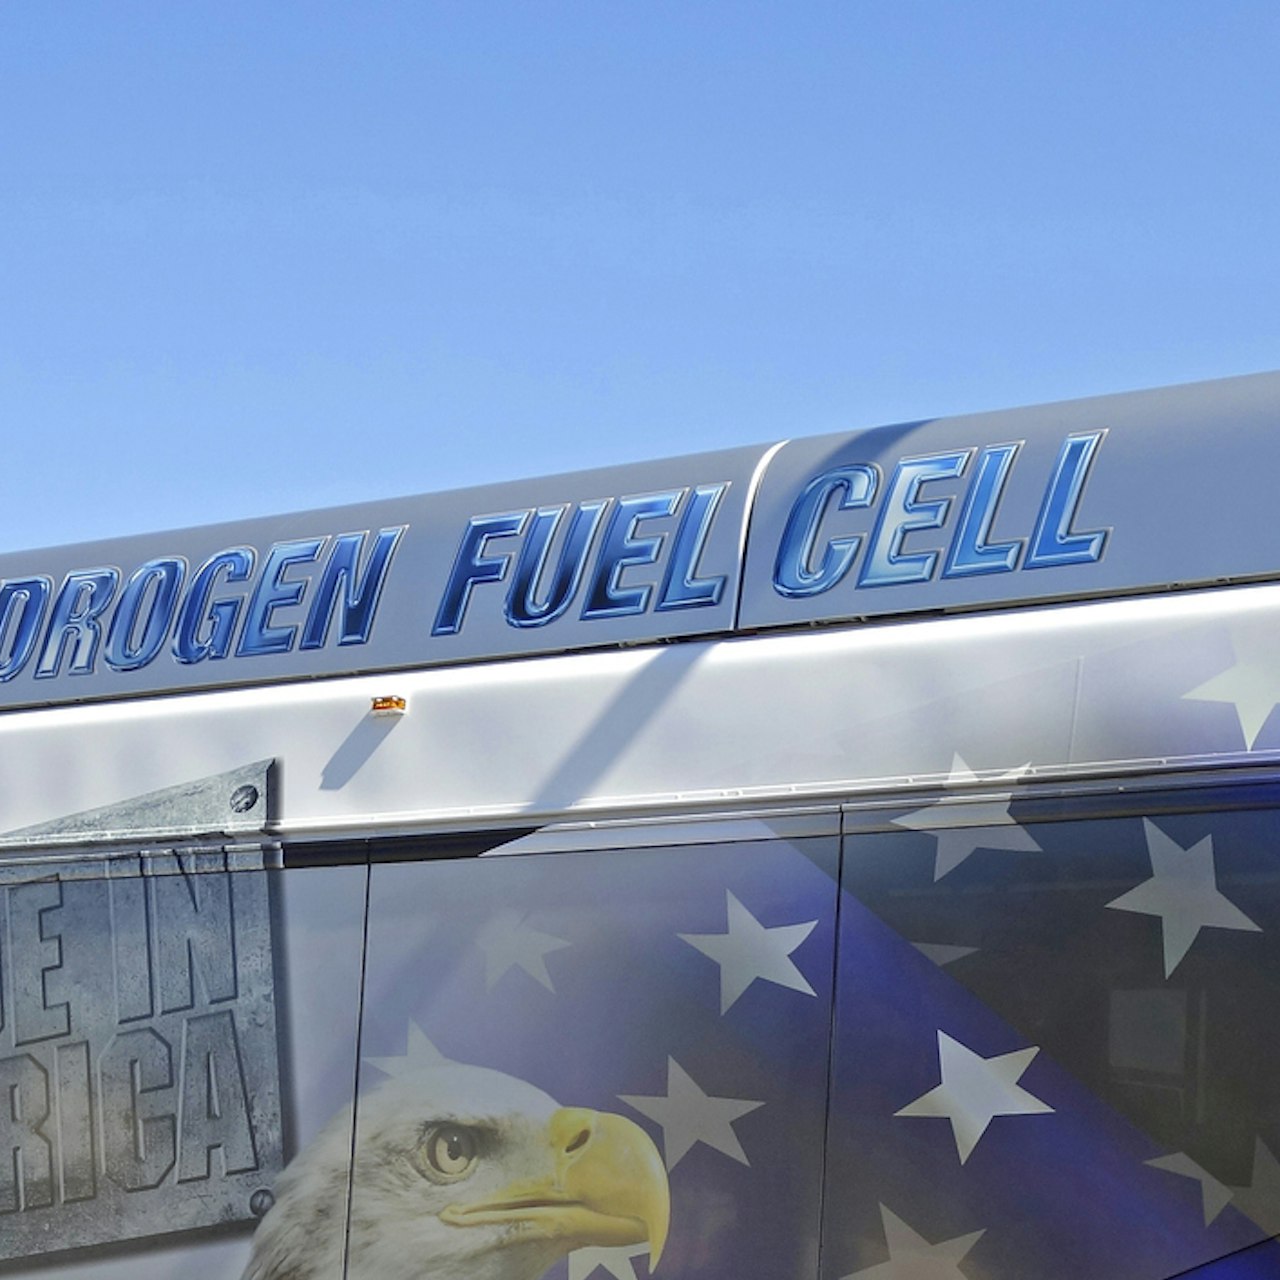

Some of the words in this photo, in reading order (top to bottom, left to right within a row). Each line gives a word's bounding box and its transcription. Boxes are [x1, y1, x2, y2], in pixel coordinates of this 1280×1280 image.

[431, 481, 732, 638] FUEL
[772, 428, 1113, 598] CELL
[104, 836, 239, 1026] IN
